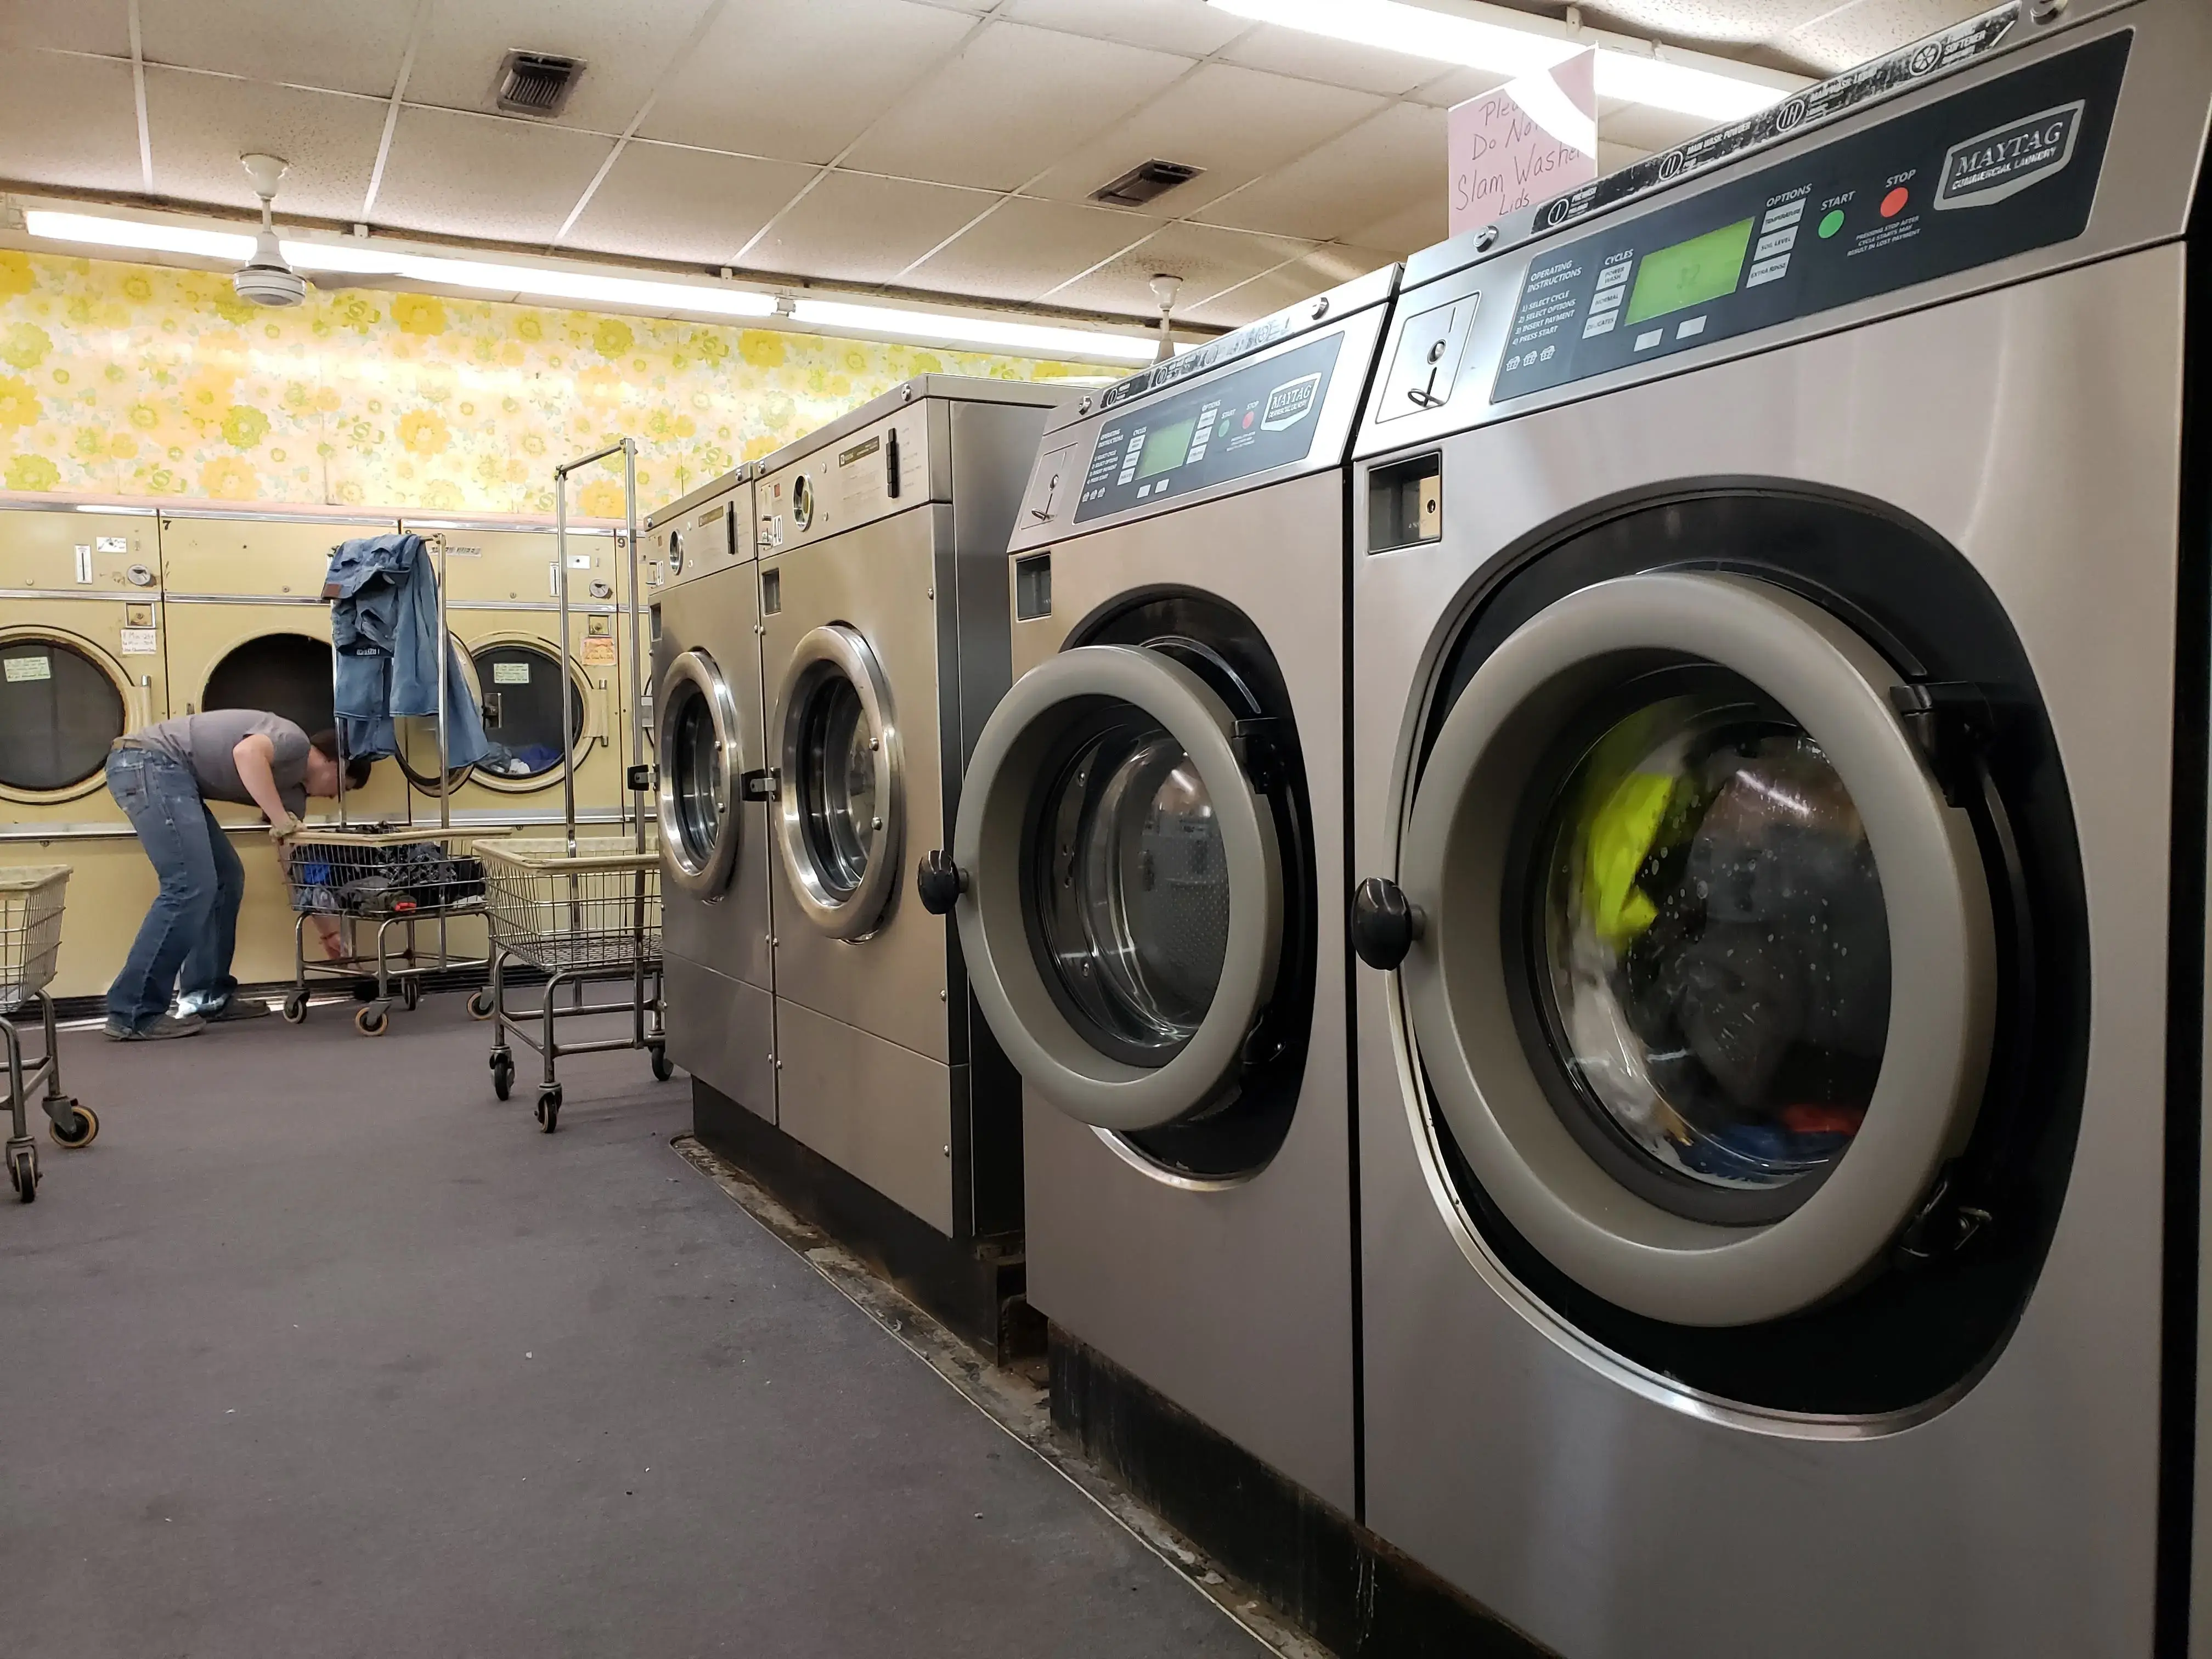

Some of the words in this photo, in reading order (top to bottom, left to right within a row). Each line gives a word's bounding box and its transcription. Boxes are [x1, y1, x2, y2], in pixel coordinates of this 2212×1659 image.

[1479, 98, 1520, 126] Plea
[1471, 133, 1497, 160] Do
[1505, 111, 1538, 149] No
[1955, 121, 2063, 177] MAYTAG
[1885, 168, 1916, 188] STOP
[1951, 162, 2012, 190] COMMERCIAL
[2013, 146, 2057, 170] LAUNDRY
[1455, 170, 1504, 211] Slam
[1499, 188, 1530, 216] Lids
[1765, 183, 1813, 208] OPTIONS
[1820, 190, 1857, 211] START
[1605, 249, 1634, 266] CYCLES
[1527, 267, 1583, 293] INSTRUCTIONS
[1531, 259, 1573, 282] OPERATING
[1526, 308, 1547, 321] SELECT
[1547, 298, 1576, 313] OPTIONS
[1528, 297, 1550, 310] SELECT
[1550, 290, 1570, 302] CYCLE
[1522, 319, 1544, 332] INSERT
[1544, 309, 1576, 325] PAYMENT
[1519, 331, 1538, 344] PRESS
[1538, 325, 1559, 337] START
[1271, 384, 1312, 410] MAYTAG
[162, 520, 172, 531] 7
[617, 537, 626, 549] 9
